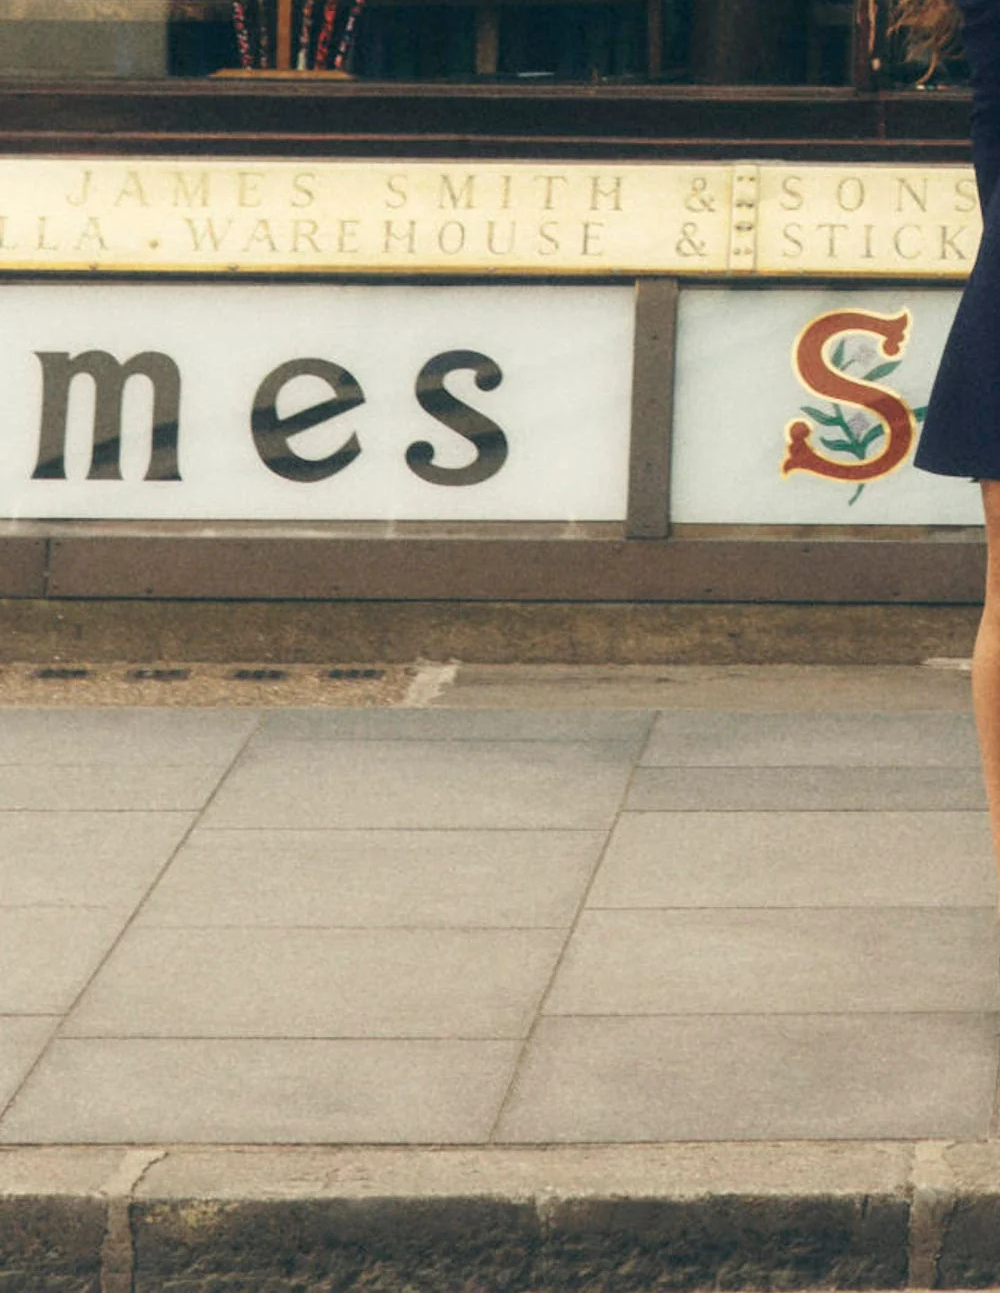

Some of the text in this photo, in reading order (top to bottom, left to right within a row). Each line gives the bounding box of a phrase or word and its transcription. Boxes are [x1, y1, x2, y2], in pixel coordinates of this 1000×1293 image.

[66, 170, 978, 213] JAMES SMITH & SONS
[184, 216, 606, 256] WAREHOUSE
[675, 221, 707, 257] &
